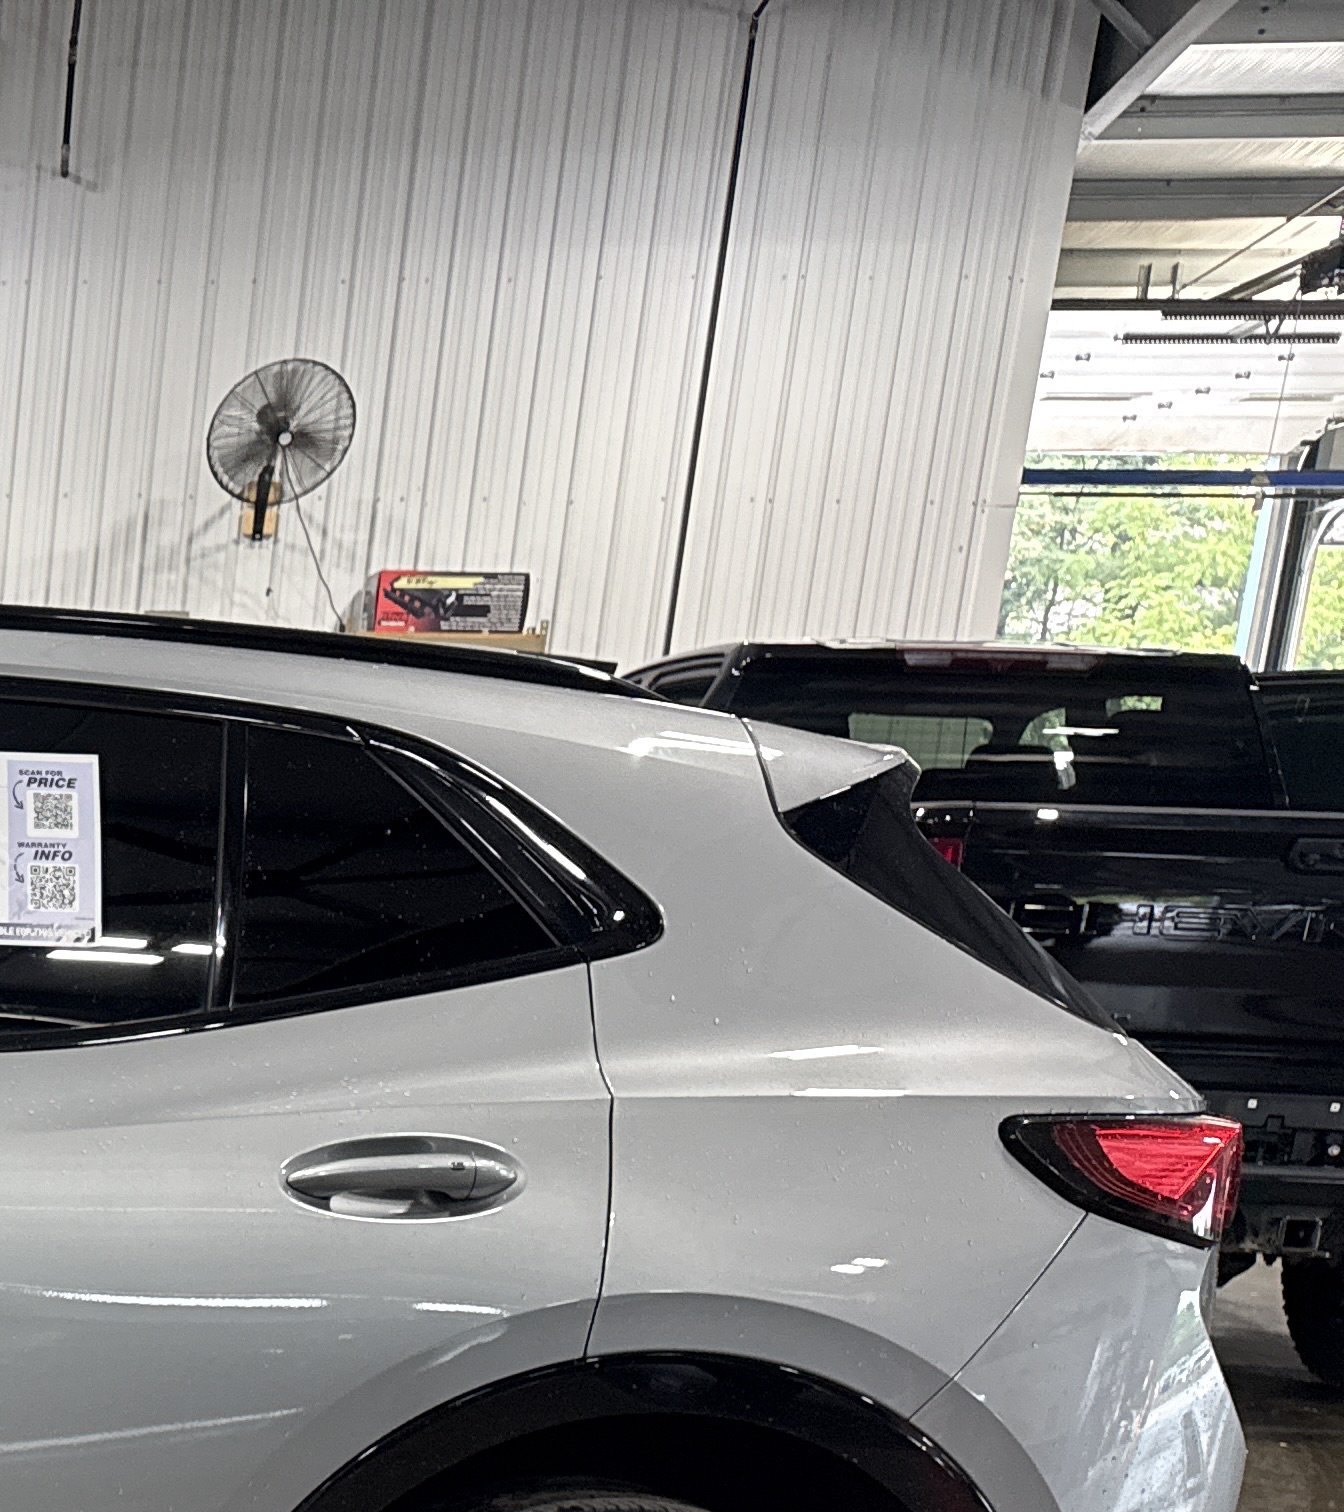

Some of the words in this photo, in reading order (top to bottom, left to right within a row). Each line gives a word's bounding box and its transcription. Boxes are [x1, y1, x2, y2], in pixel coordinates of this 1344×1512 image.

[18, 769, 43, 777] SCAN
[26, 777, 78, 789] PRICE
[33, 850, 73, 861] INFO
